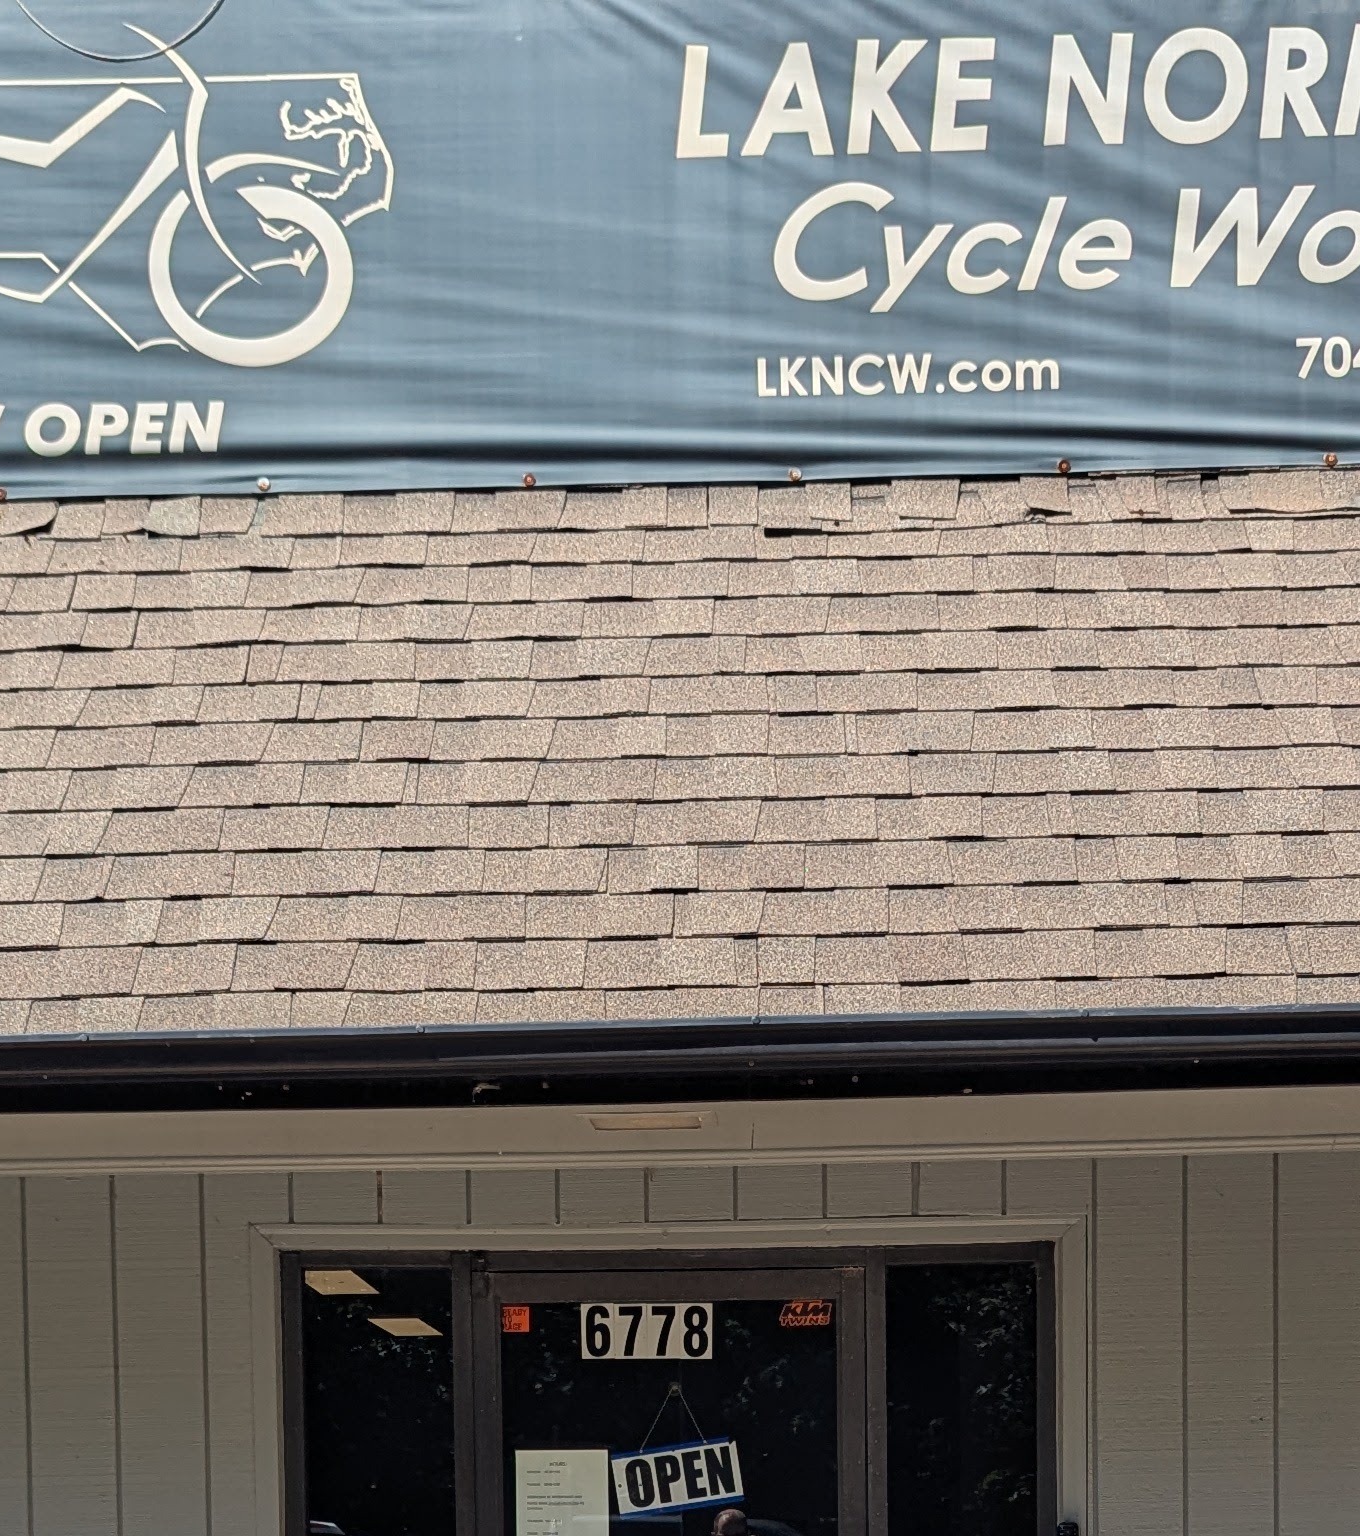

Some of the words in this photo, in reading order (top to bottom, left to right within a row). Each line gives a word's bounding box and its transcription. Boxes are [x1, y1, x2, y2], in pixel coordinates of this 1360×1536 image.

[676, 37, 995, 159] LAKE
[773, 181, 1134, 312] Cycle
[756, 351, 1060, 398] LKNCW.com
[24, 400, 225, 458] OPEN
[585, 1305, 709, 1357] 6778
[781, 1302, 831, 1316] KTM
[781, 1316, 830, 1325] TWINS
[625, 1446, 736, 1508] OPEN
